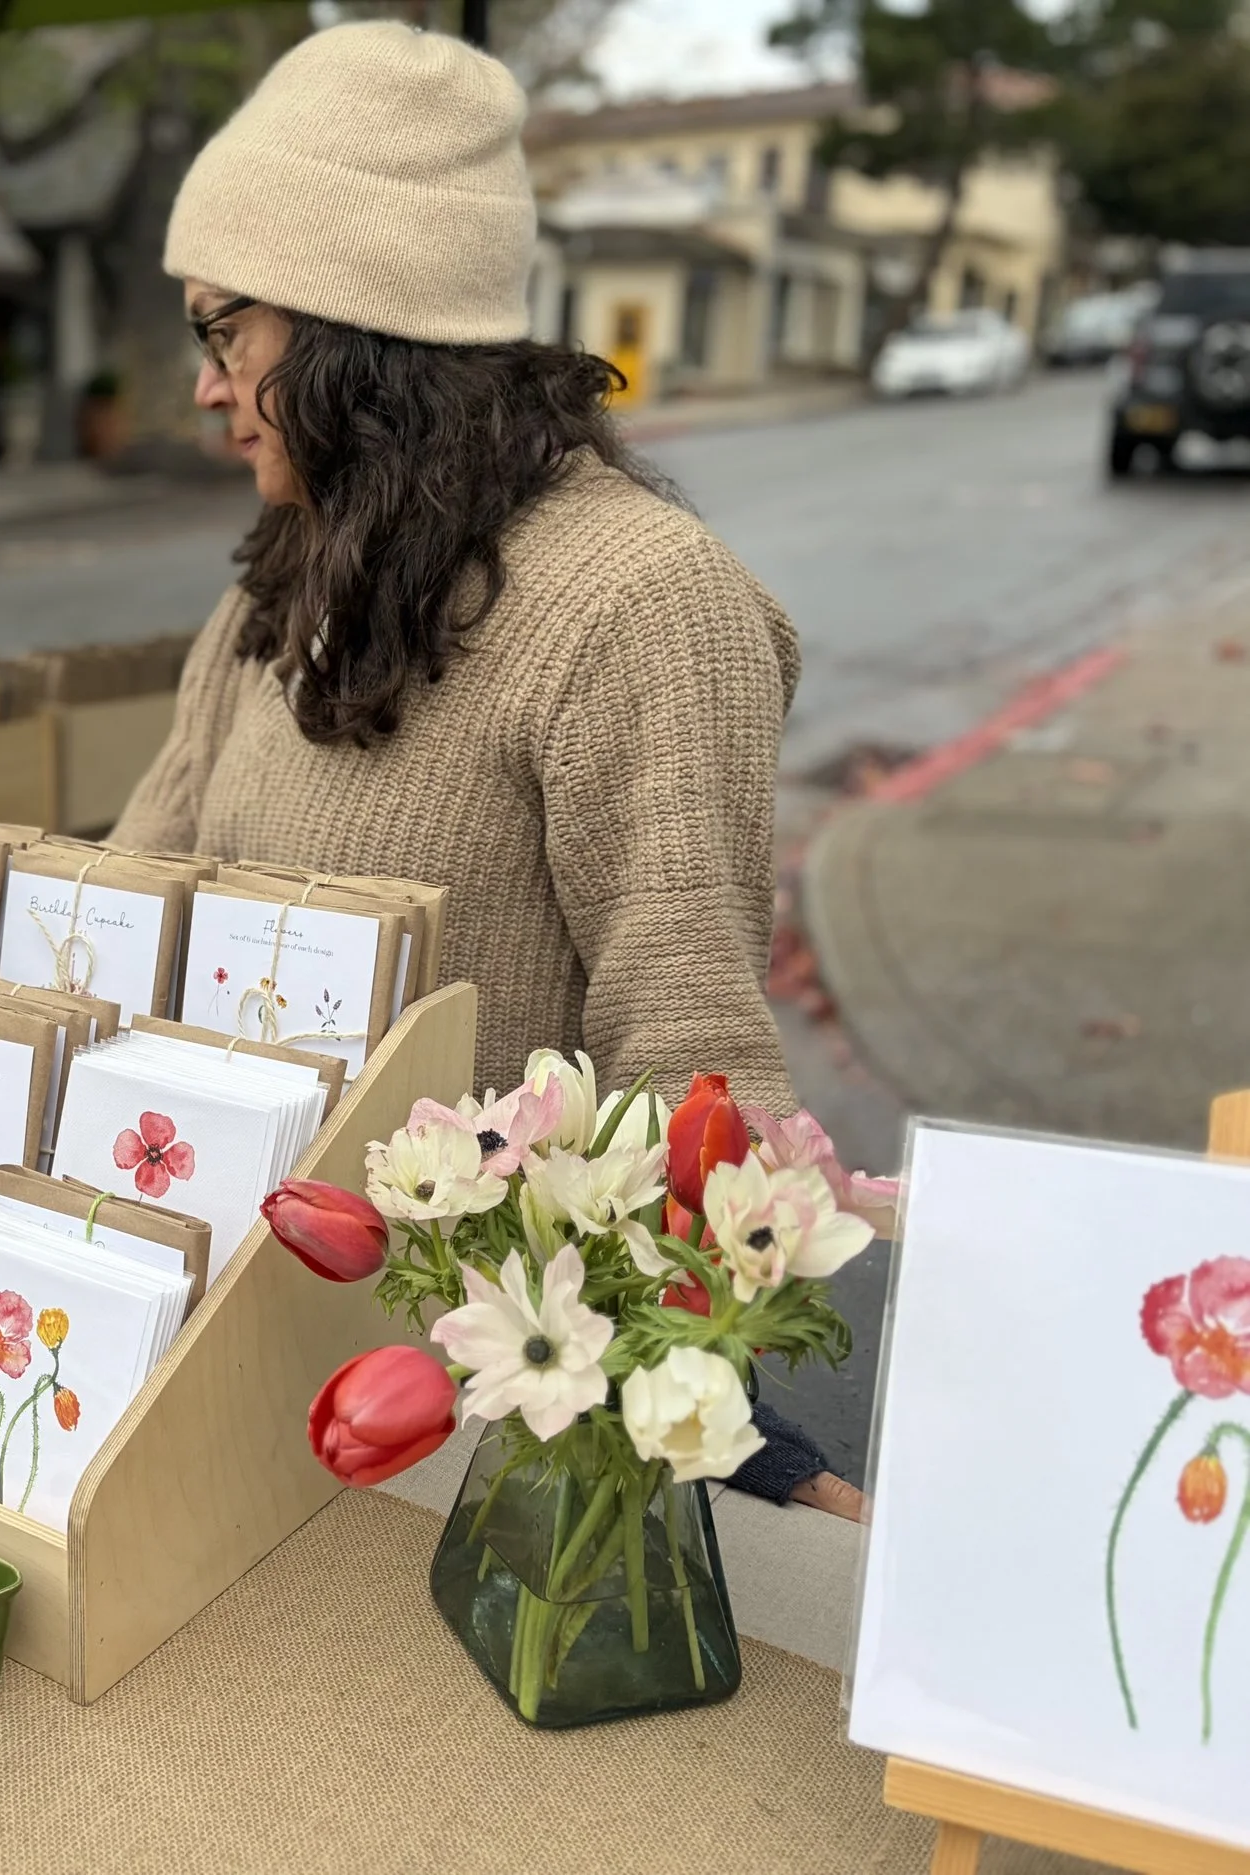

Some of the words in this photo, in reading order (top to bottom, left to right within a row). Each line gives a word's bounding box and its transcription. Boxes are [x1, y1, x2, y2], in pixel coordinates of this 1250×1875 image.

[85, 906, 135, 930] Cupcake
[291, 943, 298, 951] of
[313, 947, 334, 957] design
